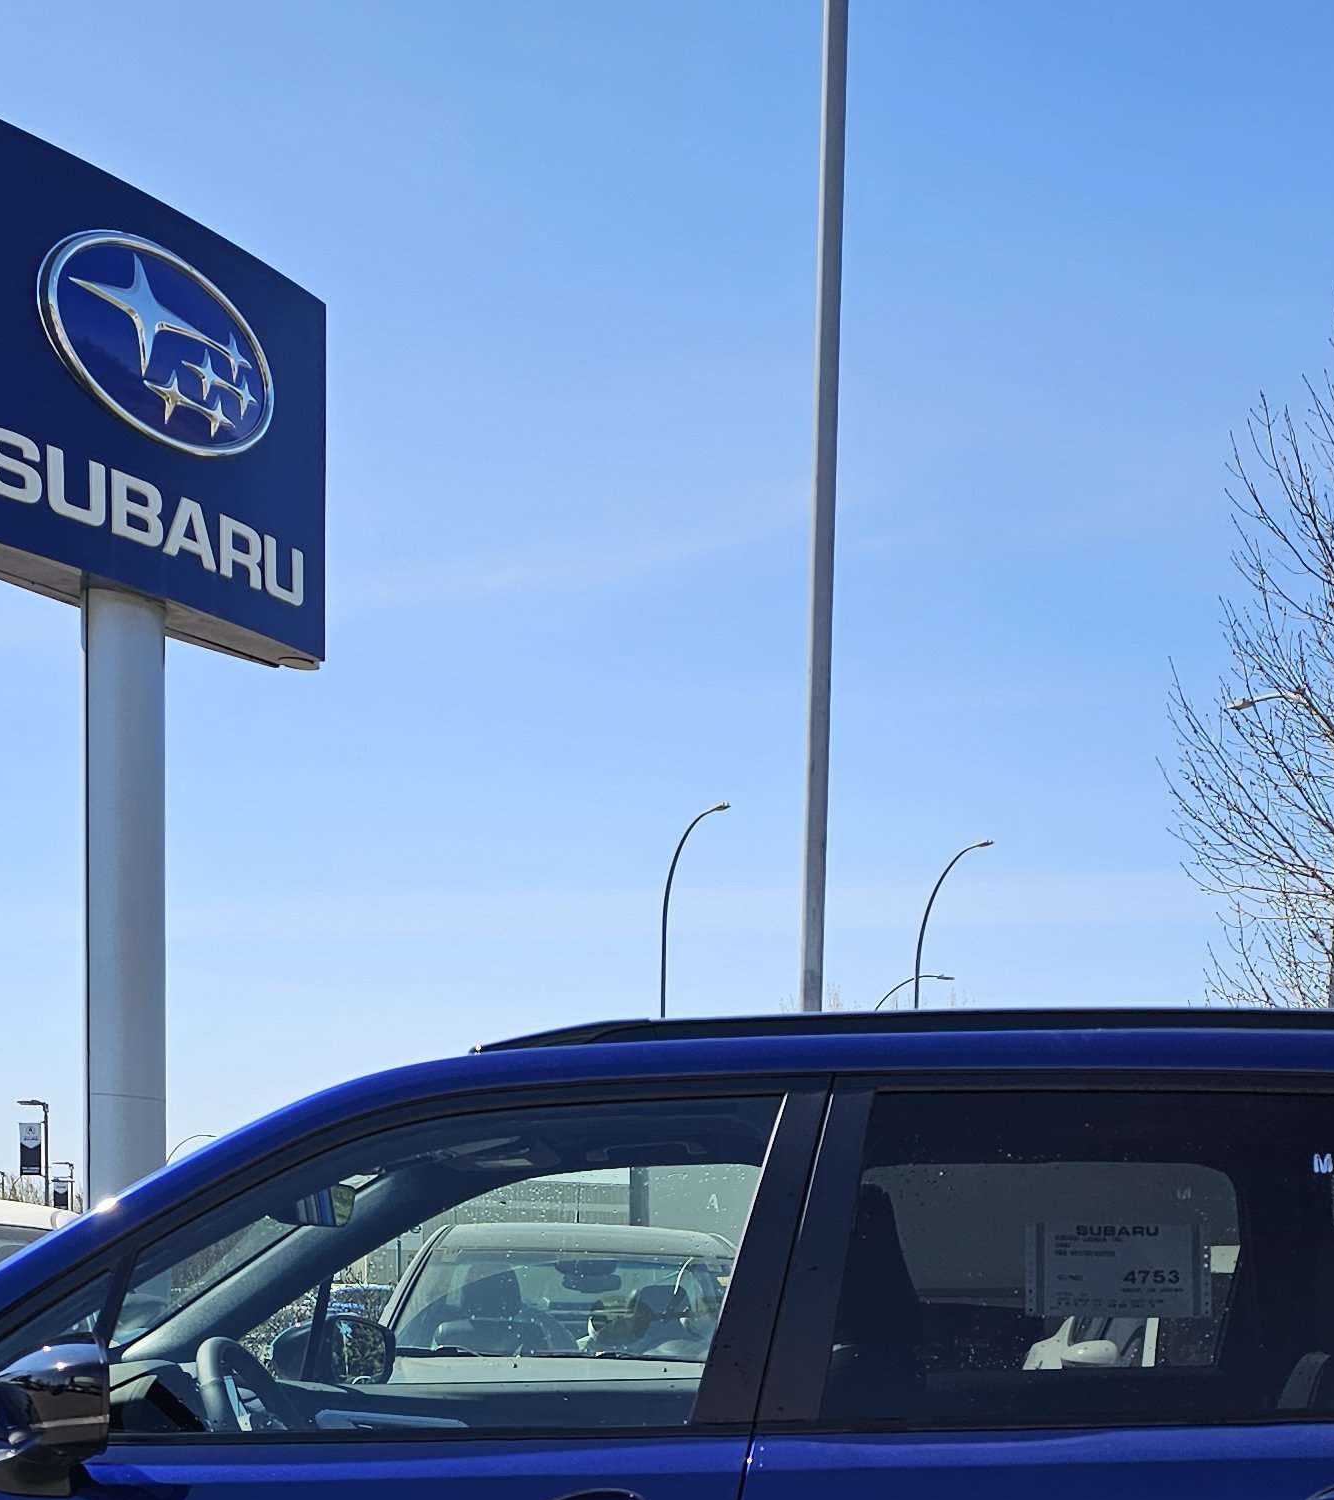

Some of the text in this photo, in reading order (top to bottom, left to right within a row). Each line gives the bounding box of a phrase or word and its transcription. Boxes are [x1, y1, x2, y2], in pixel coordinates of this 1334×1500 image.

[1313, 1153, 1333, 1173] M
[1075, 1225, 1160, 1237] SUBARU
[1123, 1269, 1180, 1284] 4753
